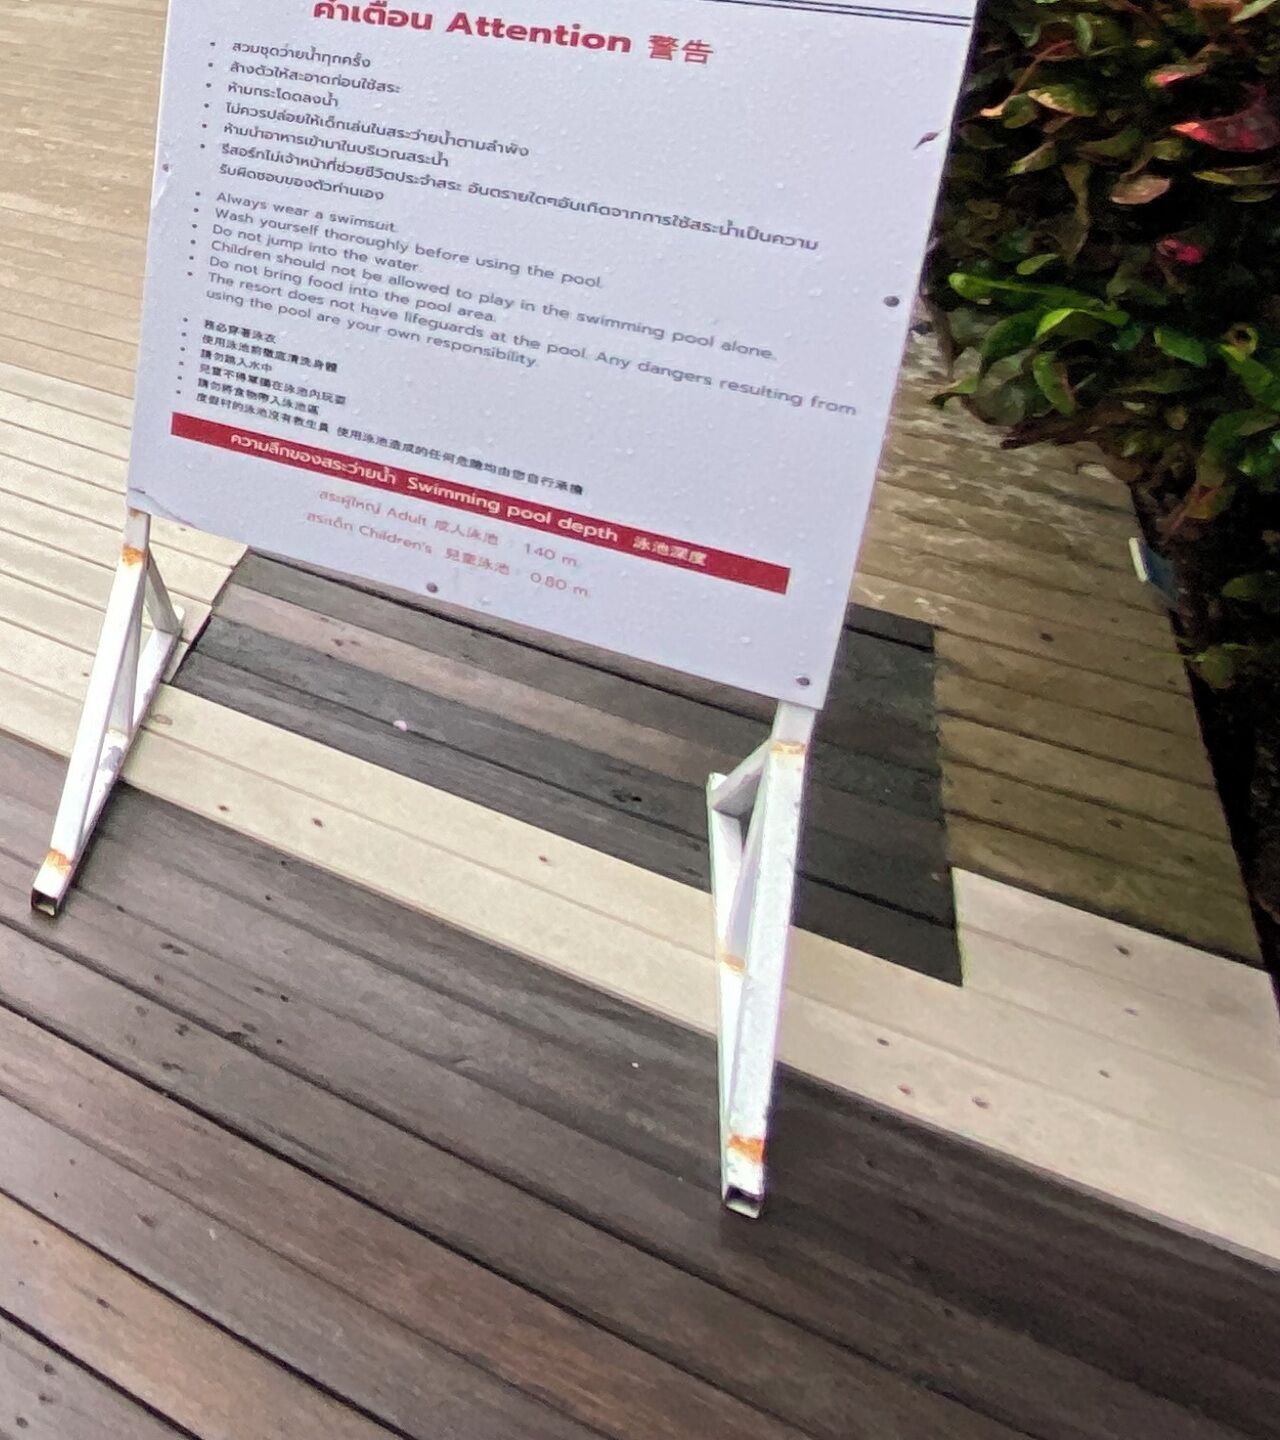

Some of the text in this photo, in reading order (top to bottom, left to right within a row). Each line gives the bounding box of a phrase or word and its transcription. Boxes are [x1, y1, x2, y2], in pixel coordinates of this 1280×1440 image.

[445, 12, 632, 53] Attention
[648, 34, 714, 64] 警告
[216, 191, 268, 211] Always
[272, 203, 310, 217] wear
[314, 211, 324, 220] a
[212, 223, 233, 237] Do
[237, 231, 262, 243] not
[265, 234, 303, 252] jump
[308, 242, 338, 257] into
[343, 248, 368, 263] the
[215, 207, 254, 224] Wash
[259, 218, 320, 236] yourself
[324, 228, 409, 254] thoroughly
[414, 243, 470, 264] before
[475, 257, 521, 276] using
[527, 264, 555, 279] the
[209, 255, 229, 269] Do
[234, 263, 258, 276] not
[263, 266, 302, 286] bring
[308, 274, 344, 292] food
[349, 283, 379, 299] into
[384, 291, 410, 305] the
[415, 299, 452, 313] pool
[211, 239, 271, 261] Children
[276, 253, 326, 271] should
[331, 265, 356, 278] not
[361, 268, 383, 282] be
[388, 275, 451, 296] allowed
[455, 287, 473, 300] to
[478, 292, 515, 310] play
[520, 299, 536, 312] in
[542, 303, 570, 319] the
[576, 312, 665, 341] swimming
[671, 332, 715, 348] pool
[206, 290, 245, 308] using
[249, 297, 273, 311] the
[277, 305, 312, 319] pool
[316, 313, 341, 326] are
[346, 319, 382, 333] your
[387, 328, 421, 342] own
[208, 271, 235, 287] The
[239, 281, 282, 297] resort
[287, 289, 324, 306] does
[329, 299, 355, 312] not
[360, 302, 399, 320] have
[404, 311, 484, 338] lifeguards
[489, 331, 507, 343] at
[513, 334, 542, 350] the
[594, 351, 631, 370] Any
[637, 361, 712, 386] dangers
[719, 380, 804, 408] resulting
[810, 395, 857, 416] from
[386, 507, 427, 527] Adult
[407, 477, 500, 514] Swimming
[507, 505, 552, 524] pool
[558, 517, 618, 542] depth
[358, 525, 433, 555] Children's
